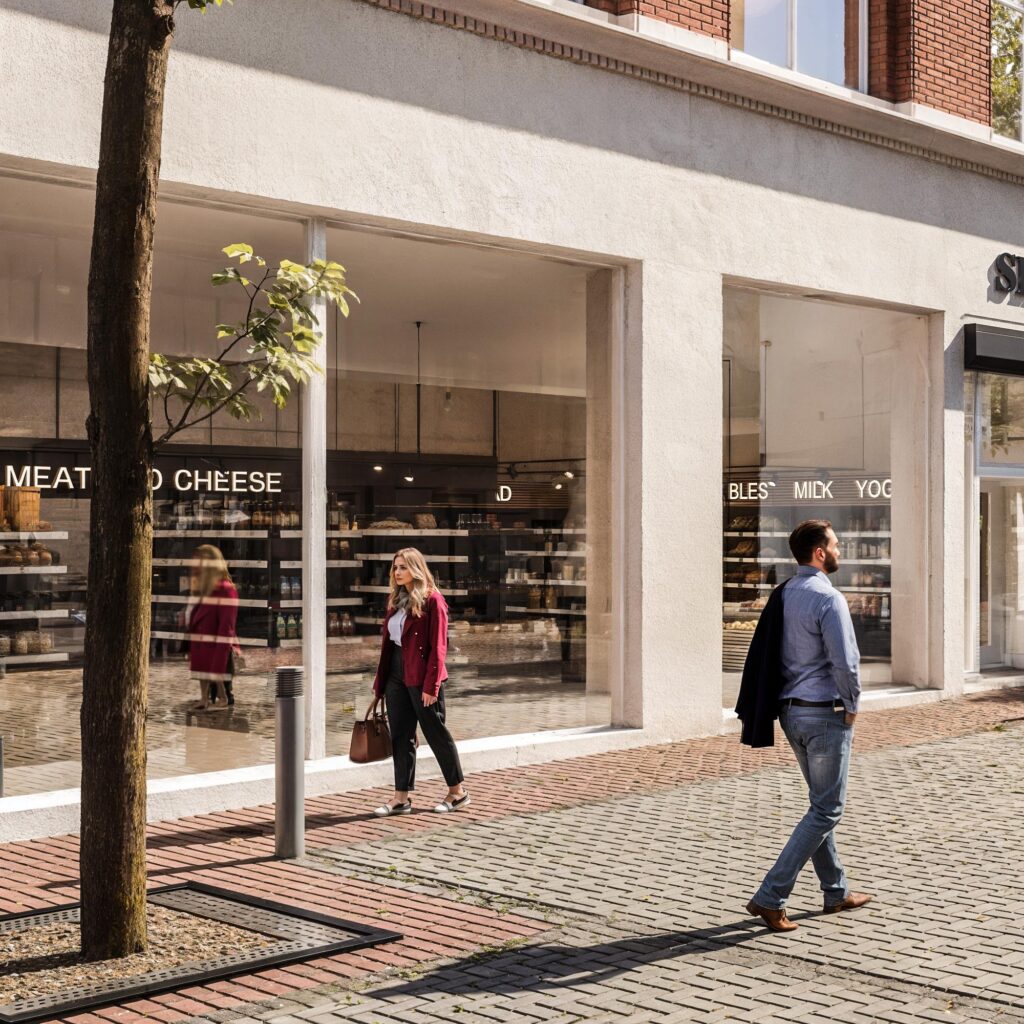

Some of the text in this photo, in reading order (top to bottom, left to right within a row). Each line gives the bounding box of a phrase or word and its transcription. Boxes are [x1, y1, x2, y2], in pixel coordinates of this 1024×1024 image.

[5, 465, 91, 489] MEAT
[174, 469, 282, 493] CHEESE
[793, 480, 834, 499] MILK
